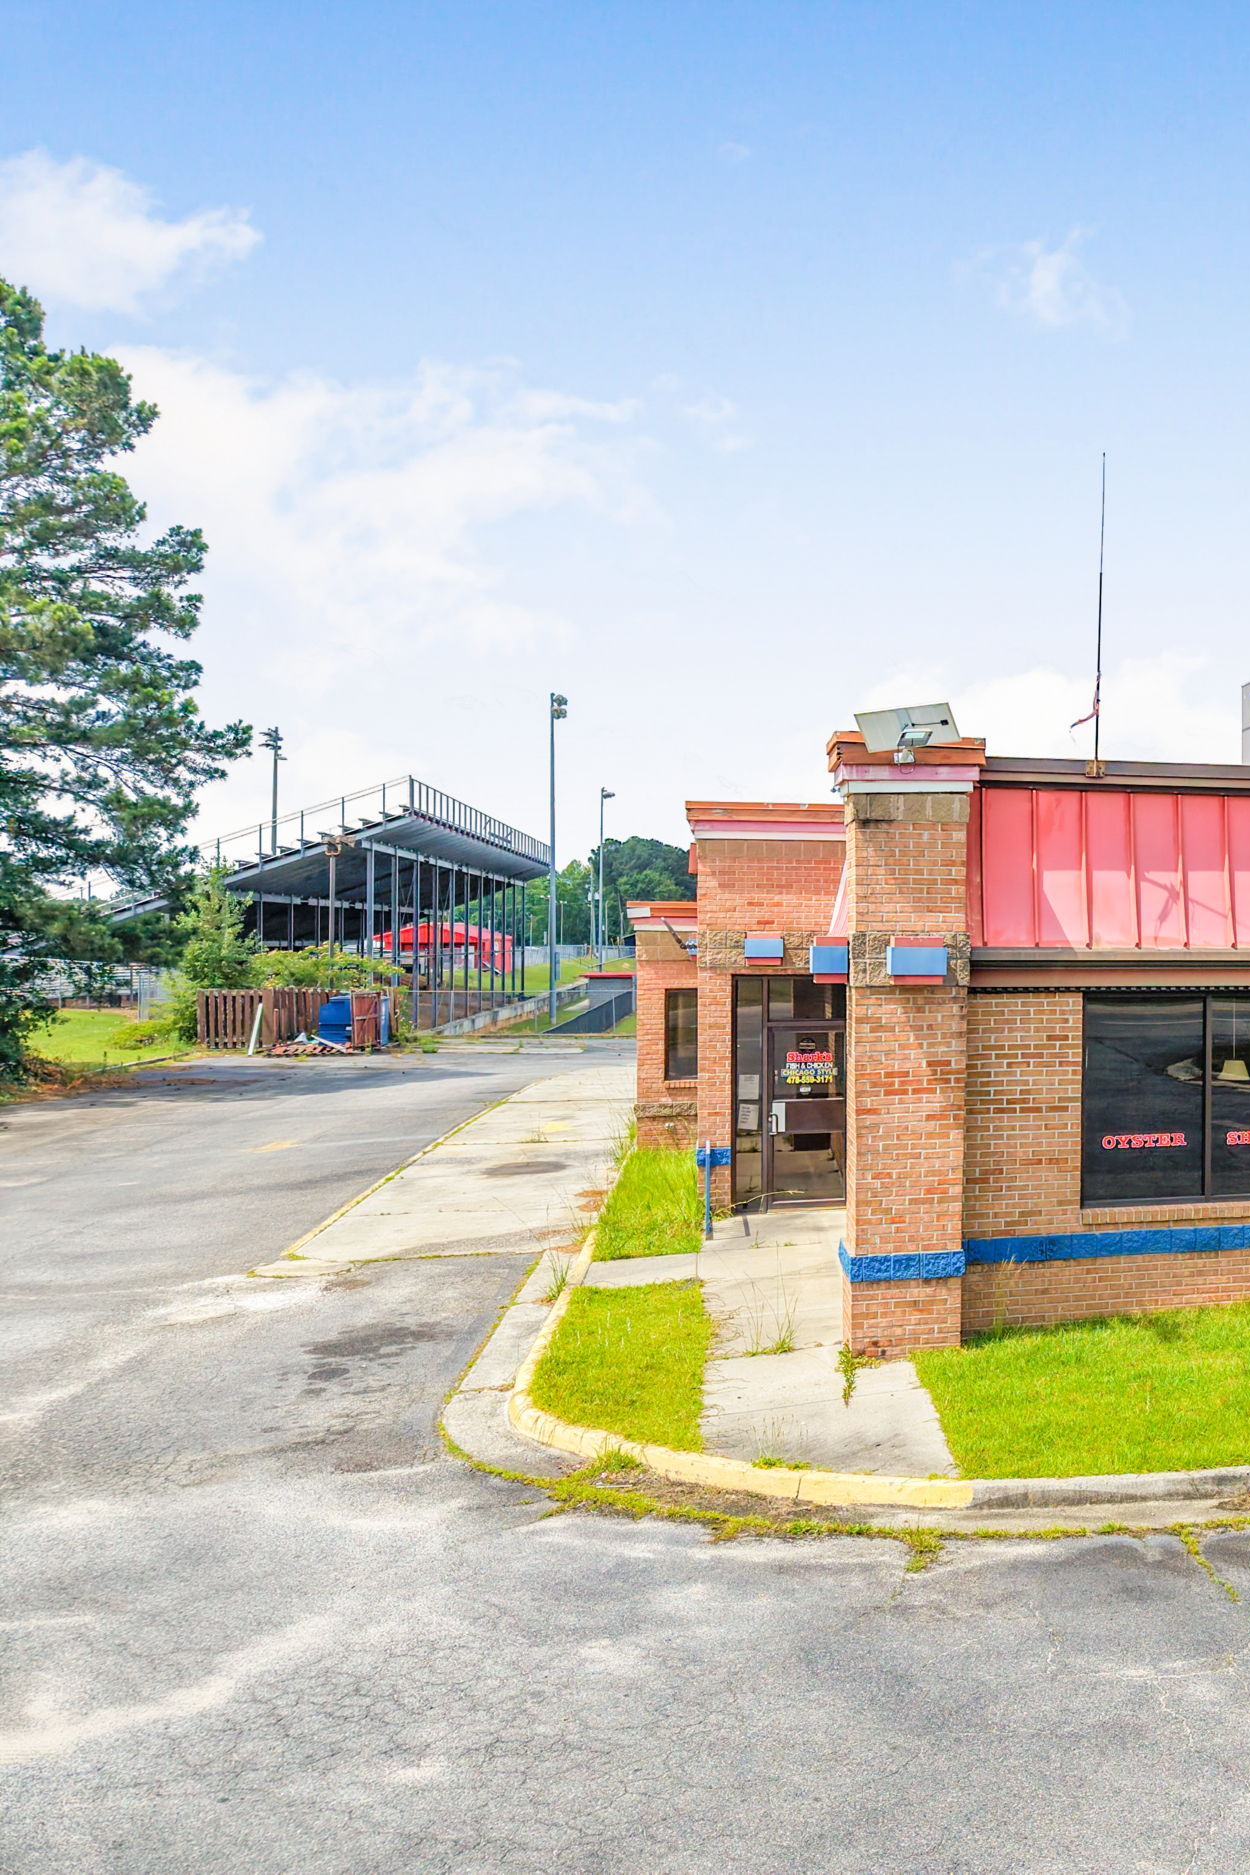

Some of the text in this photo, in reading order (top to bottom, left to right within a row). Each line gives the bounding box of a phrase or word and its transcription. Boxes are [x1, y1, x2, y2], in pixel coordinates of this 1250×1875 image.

[786, 1051, 833, 1063] Shark's
[786, 1061, 833, 1070] FISH & CHICKEN
[782, 1067, 836, 1076] CHICAGO STYLE
[1101, 1132, 1188, 1150] OYSTER
